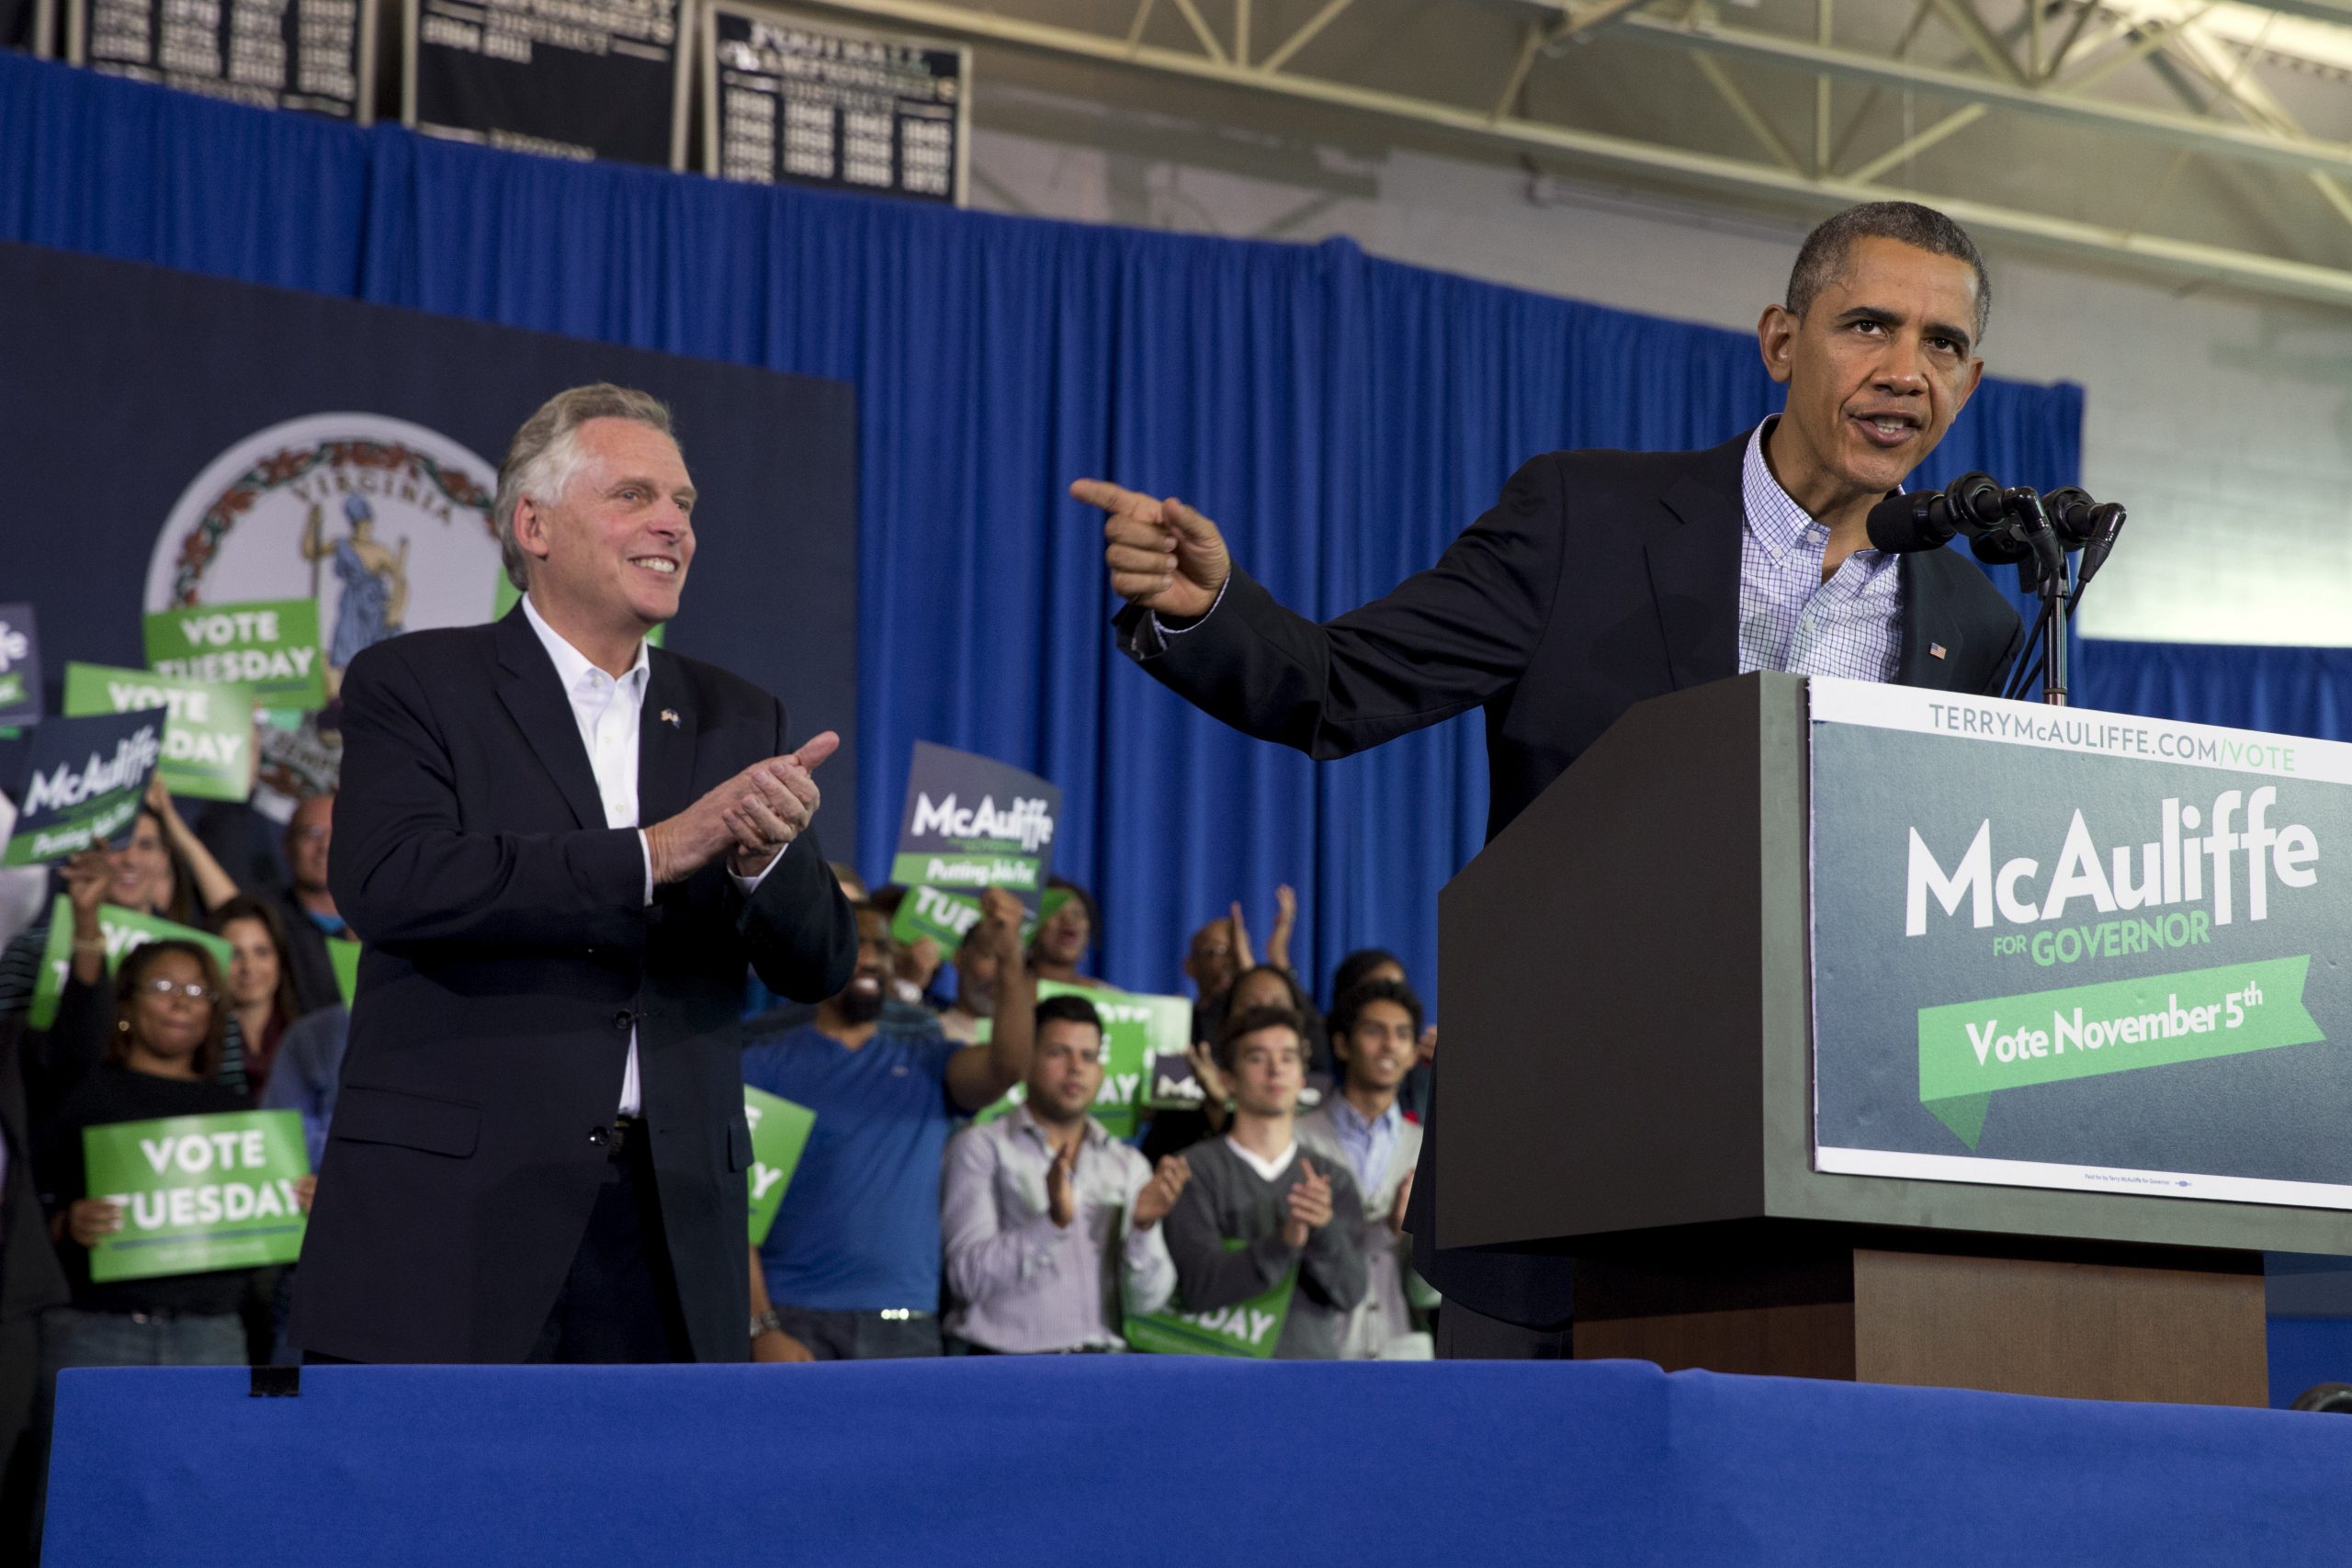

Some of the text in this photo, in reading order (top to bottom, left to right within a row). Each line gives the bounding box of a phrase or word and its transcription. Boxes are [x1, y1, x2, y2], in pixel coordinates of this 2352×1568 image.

[291, 467, 454, 526] VIRGINIA
[181, 610, 279, 645] VOTE
[107, 682, 210, 723] VOTE
[1929, 704, 2296, 772] TERRYMcAULIFFE.COM/VOTE
[910, 791, 1054, 852] McAuliffe
[1905, 785, 2320, 937] McAuliffe
[1993, 909, 2211, 967] FOR GOVERNOR
[1965, 980, 2263, 1066] Vote November 5th
[141, 1131, 266, 1173] VOTE
